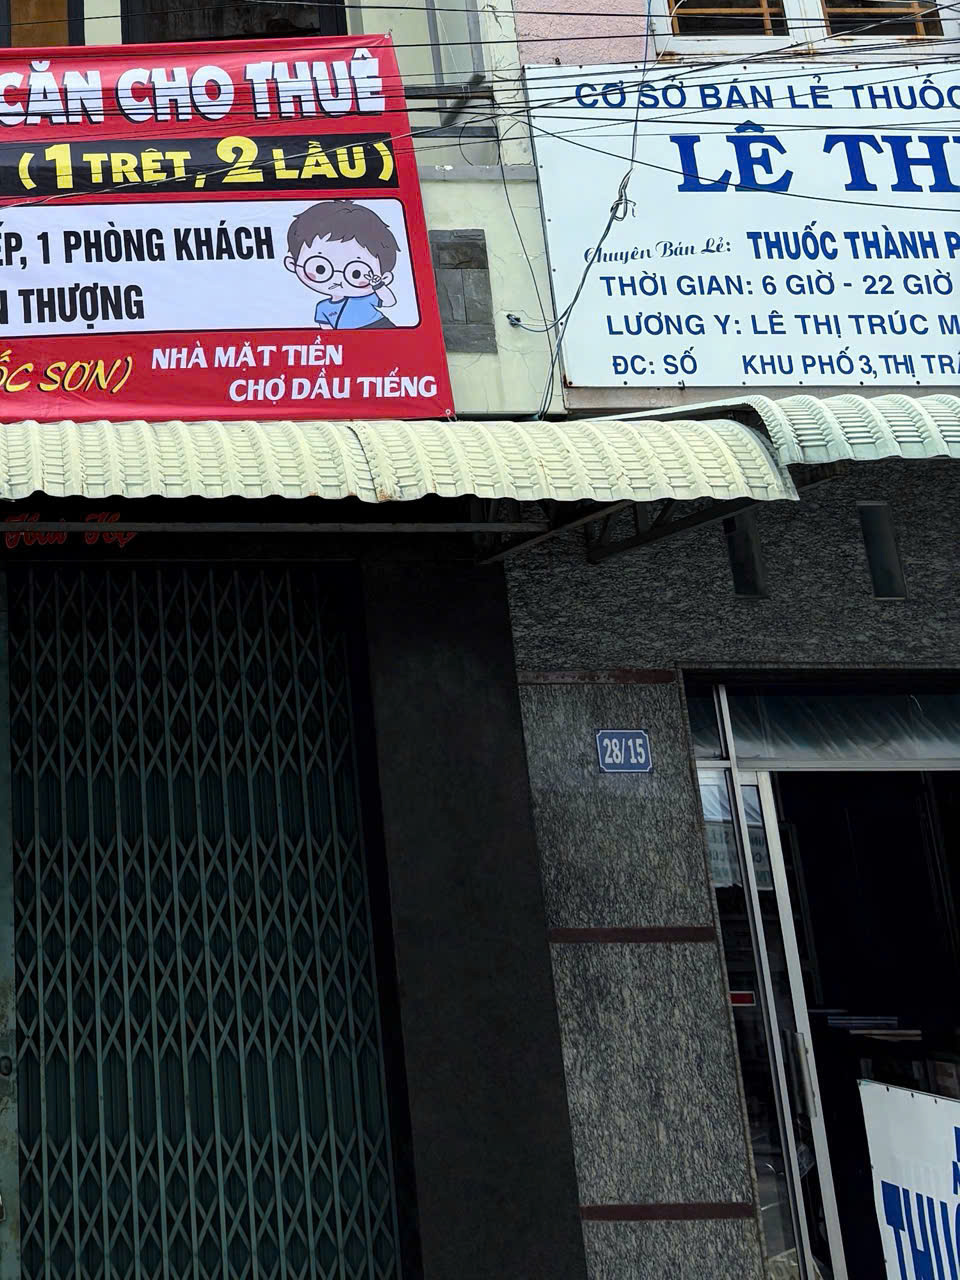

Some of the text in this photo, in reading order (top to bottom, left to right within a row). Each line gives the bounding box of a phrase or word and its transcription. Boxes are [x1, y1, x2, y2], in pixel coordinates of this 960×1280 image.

[117, 65, 234, 122] CHO
[245, 49, 385, 118] THUÊ
[575, 79, 627, 109] CƠ
[639, 77, 688, 110] SỞ
[700, 77, 772, 109] BÁN
[790, 75, 832, 108] LẺ
[216, 136, 263, 183] 2
[669, 120, 960, 192] LÊ TH
[37, 231, 50, 263] 1
[65, 221, 165, 263] PHÒNG
[175, 220, 274, 261] KHÁCH
[584, 247, 653, 264] Chuyên
[655, 240, 696, 258] Bán
[700, 237, 731, 254] Lẻ:
[747, 221, 838, 259] THUỐC
[844, 225, 938, 259] THÀNH
[600, 271, 667, 296] THỜI
[676, 275, 753, 296] GIAN:
[762, 278, 777, 296] 6
[786, 270, 835, 296] GIỜ
[863, 275, 895, 296] 22
[903, 269, 953, 296] GIỜ
[18, 284, 145, 330] THƯỢNG
[607, 311, 705, 336] LƯƠNG
[715, 314, 741, 335] Y:
[751, 310, 787, 335] LÊ
[795, 314, 842, 338] THỊ
[848, 308, 929, 336] TRÚC
[151, 335, 343, 373] NHÀ MẶT TIỀN
[613, 354, 654, 376] ĐC:
[663, 346, 698, 376] SỐ
[742, 355, 794, 375] KHU
[802, 346, 855, 375] PHỐ
[38, 355, 133, 395] SƠN)
[229, 366, 438, 406] CHỢ DẦU TIẾNG
[602, 738, 646, 764] 28/15
